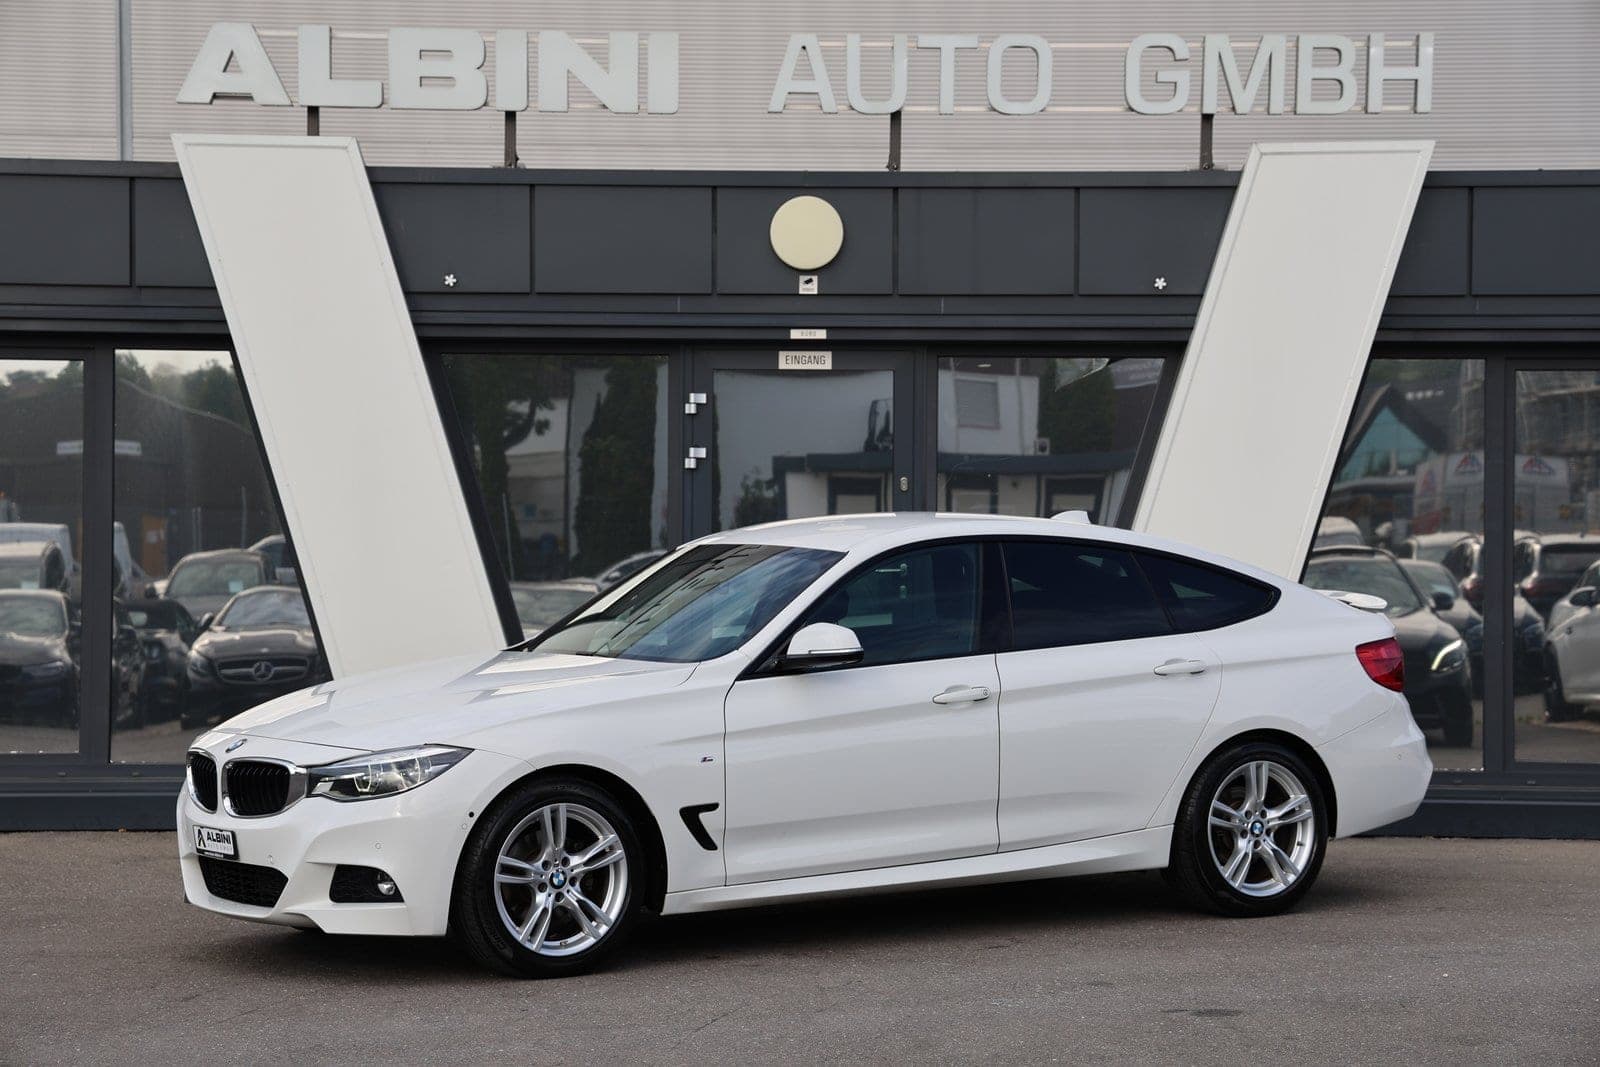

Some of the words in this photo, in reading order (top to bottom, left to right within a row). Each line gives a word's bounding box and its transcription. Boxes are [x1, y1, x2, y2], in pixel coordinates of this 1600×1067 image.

[176, 22, 680, 115] ALBINI
[768, 32, 1053, 115] AUTO
[1123, 31, 1435, 115] GMBH
[785, 354, 826, 365] EINGANG
[207, 831, 231, 844] ALBINI
